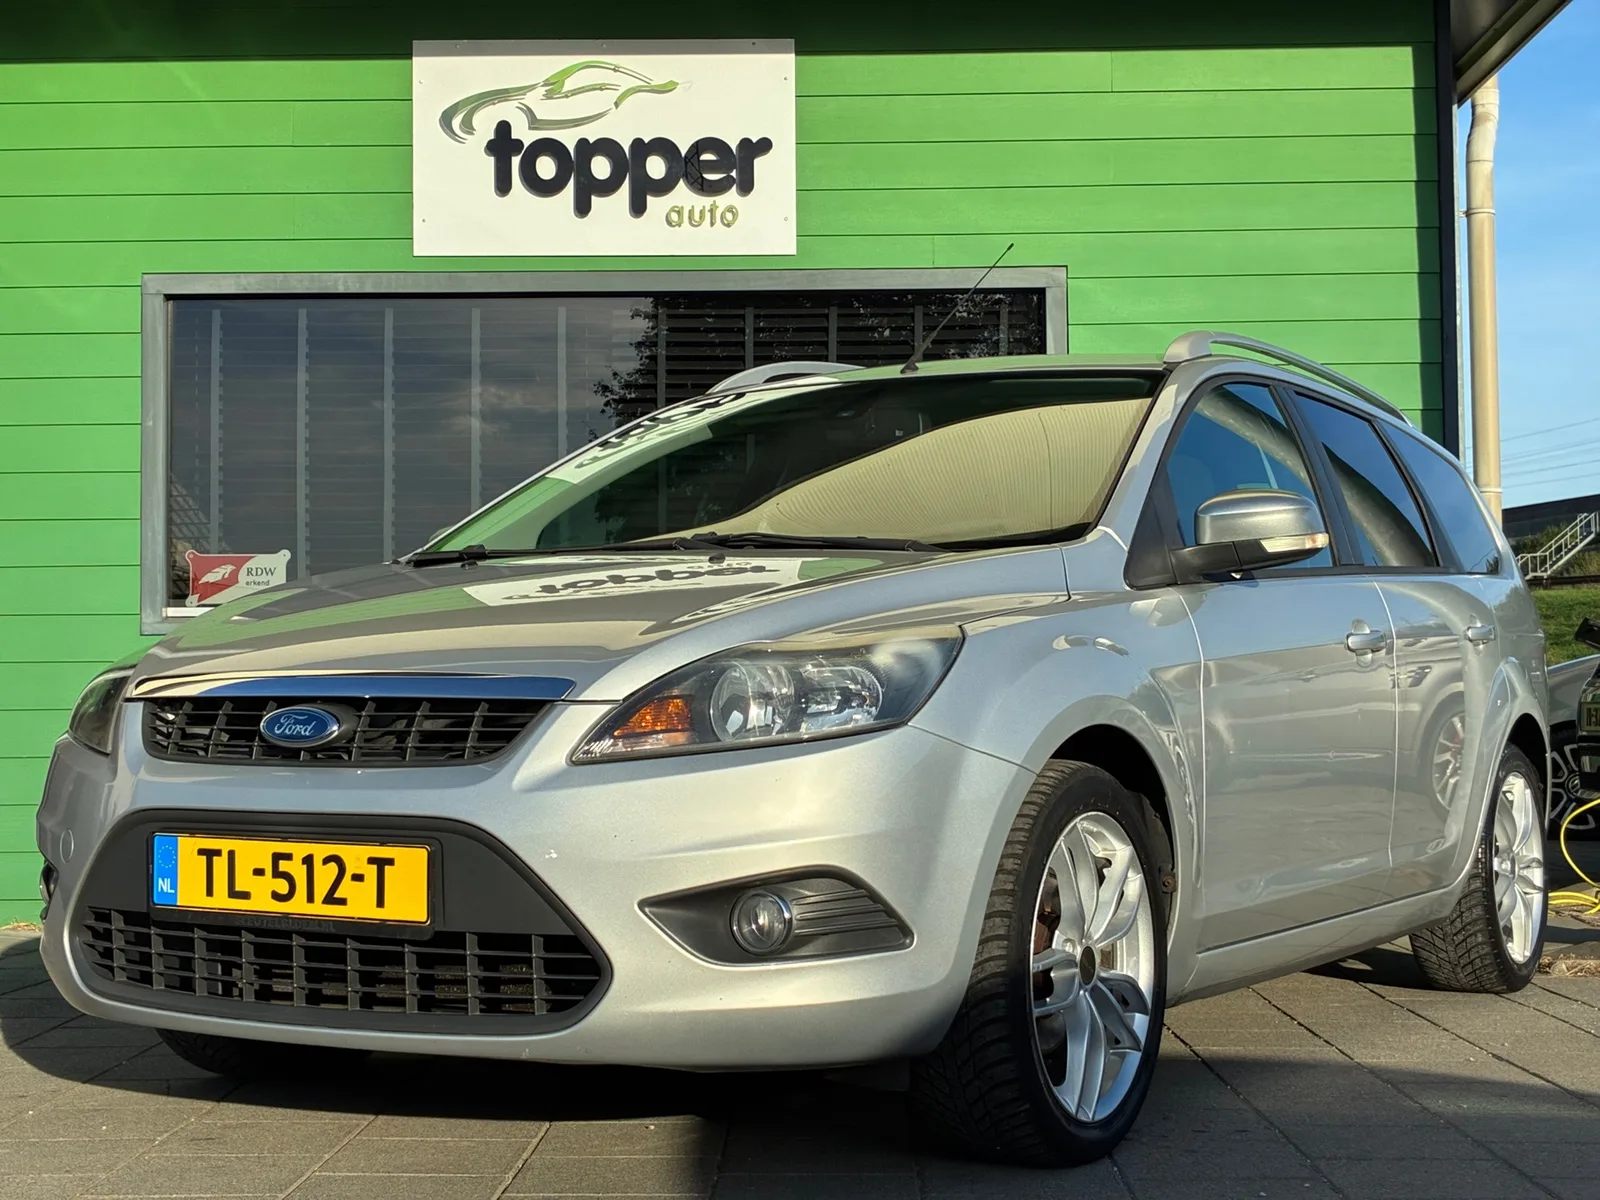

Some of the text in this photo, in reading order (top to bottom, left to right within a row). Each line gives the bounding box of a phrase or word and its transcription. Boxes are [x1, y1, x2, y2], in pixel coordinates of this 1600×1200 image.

[484, 119, 773, 219] topper
[665, 200, 739, 228] auto
[245, 566, 277, 577] RDW
[245, 579, 270, 587] erkend
[274, 713, 315, 736] Ford
[157, 877, 176, 894] NL
[196, 847, 396, 909] TL-512-T
